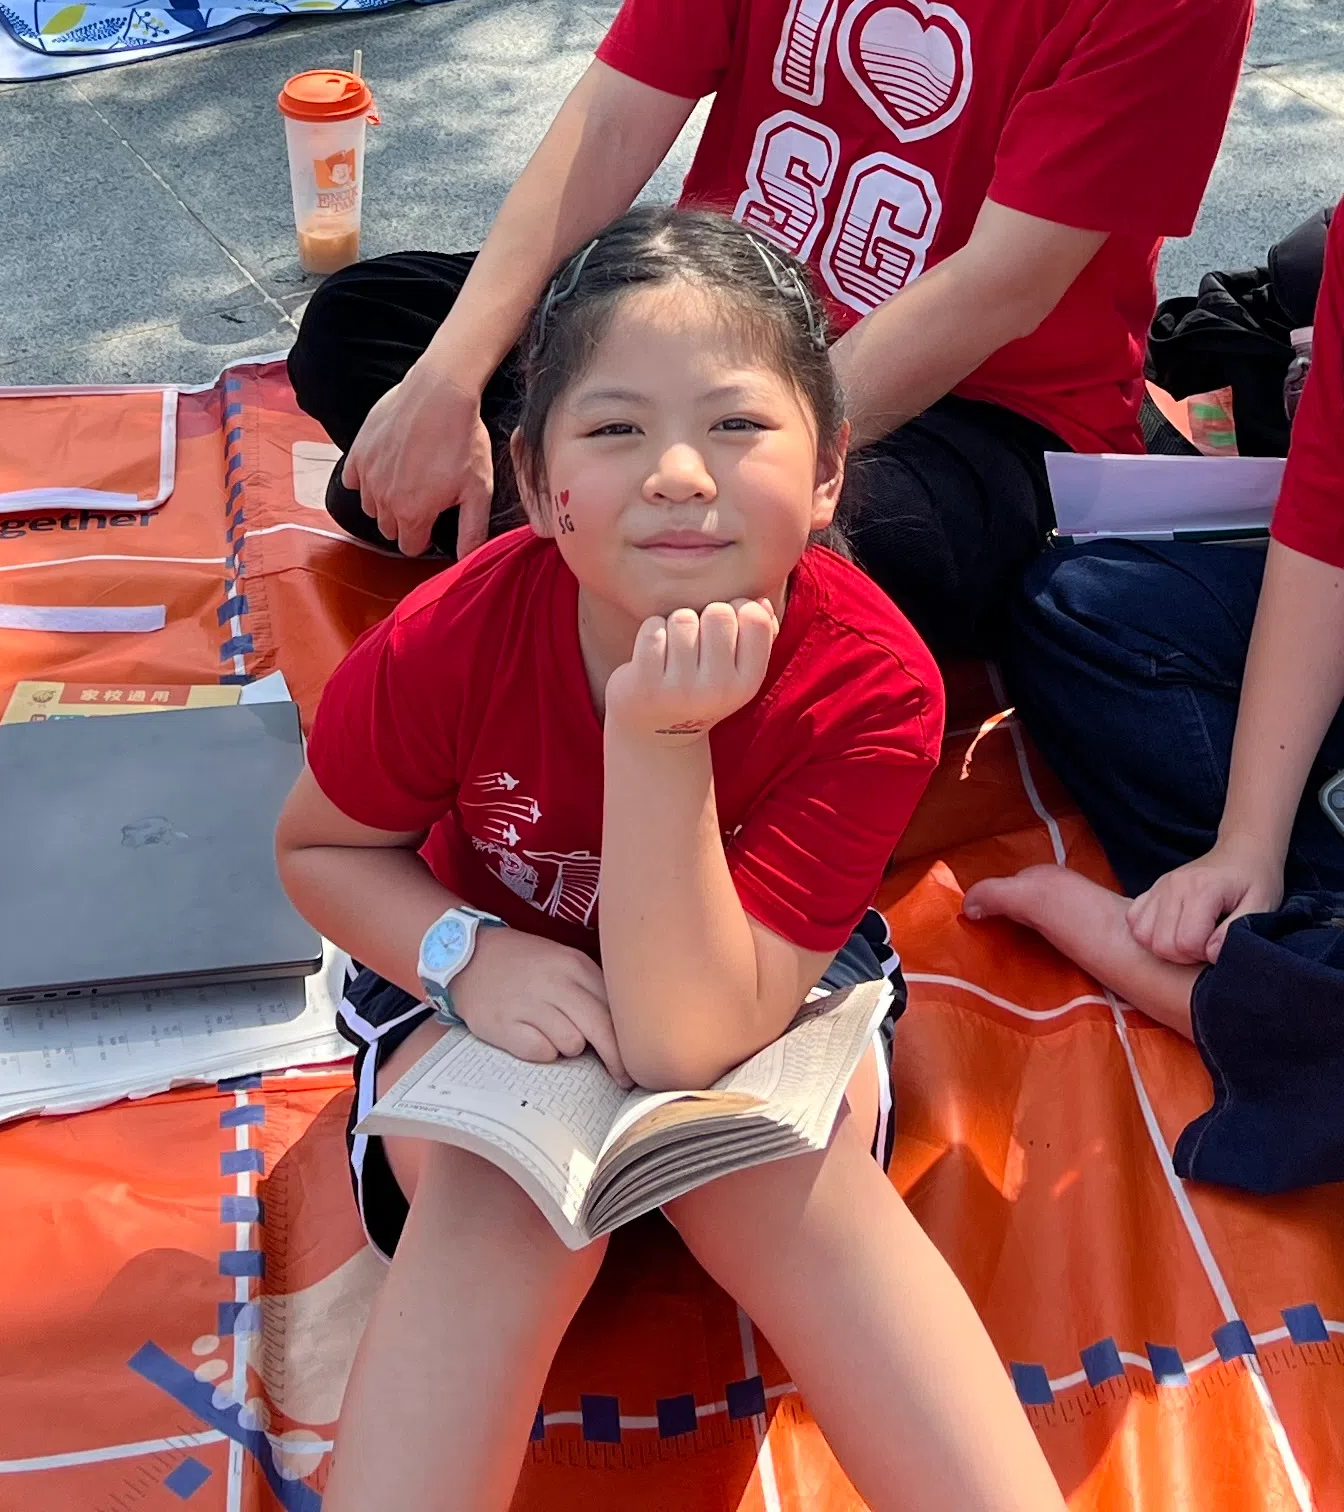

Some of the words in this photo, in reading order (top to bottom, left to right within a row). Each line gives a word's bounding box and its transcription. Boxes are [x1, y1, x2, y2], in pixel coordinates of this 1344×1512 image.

[733, 109, 943, 316] SG
[79, 690, 170, 703] 家校通用
